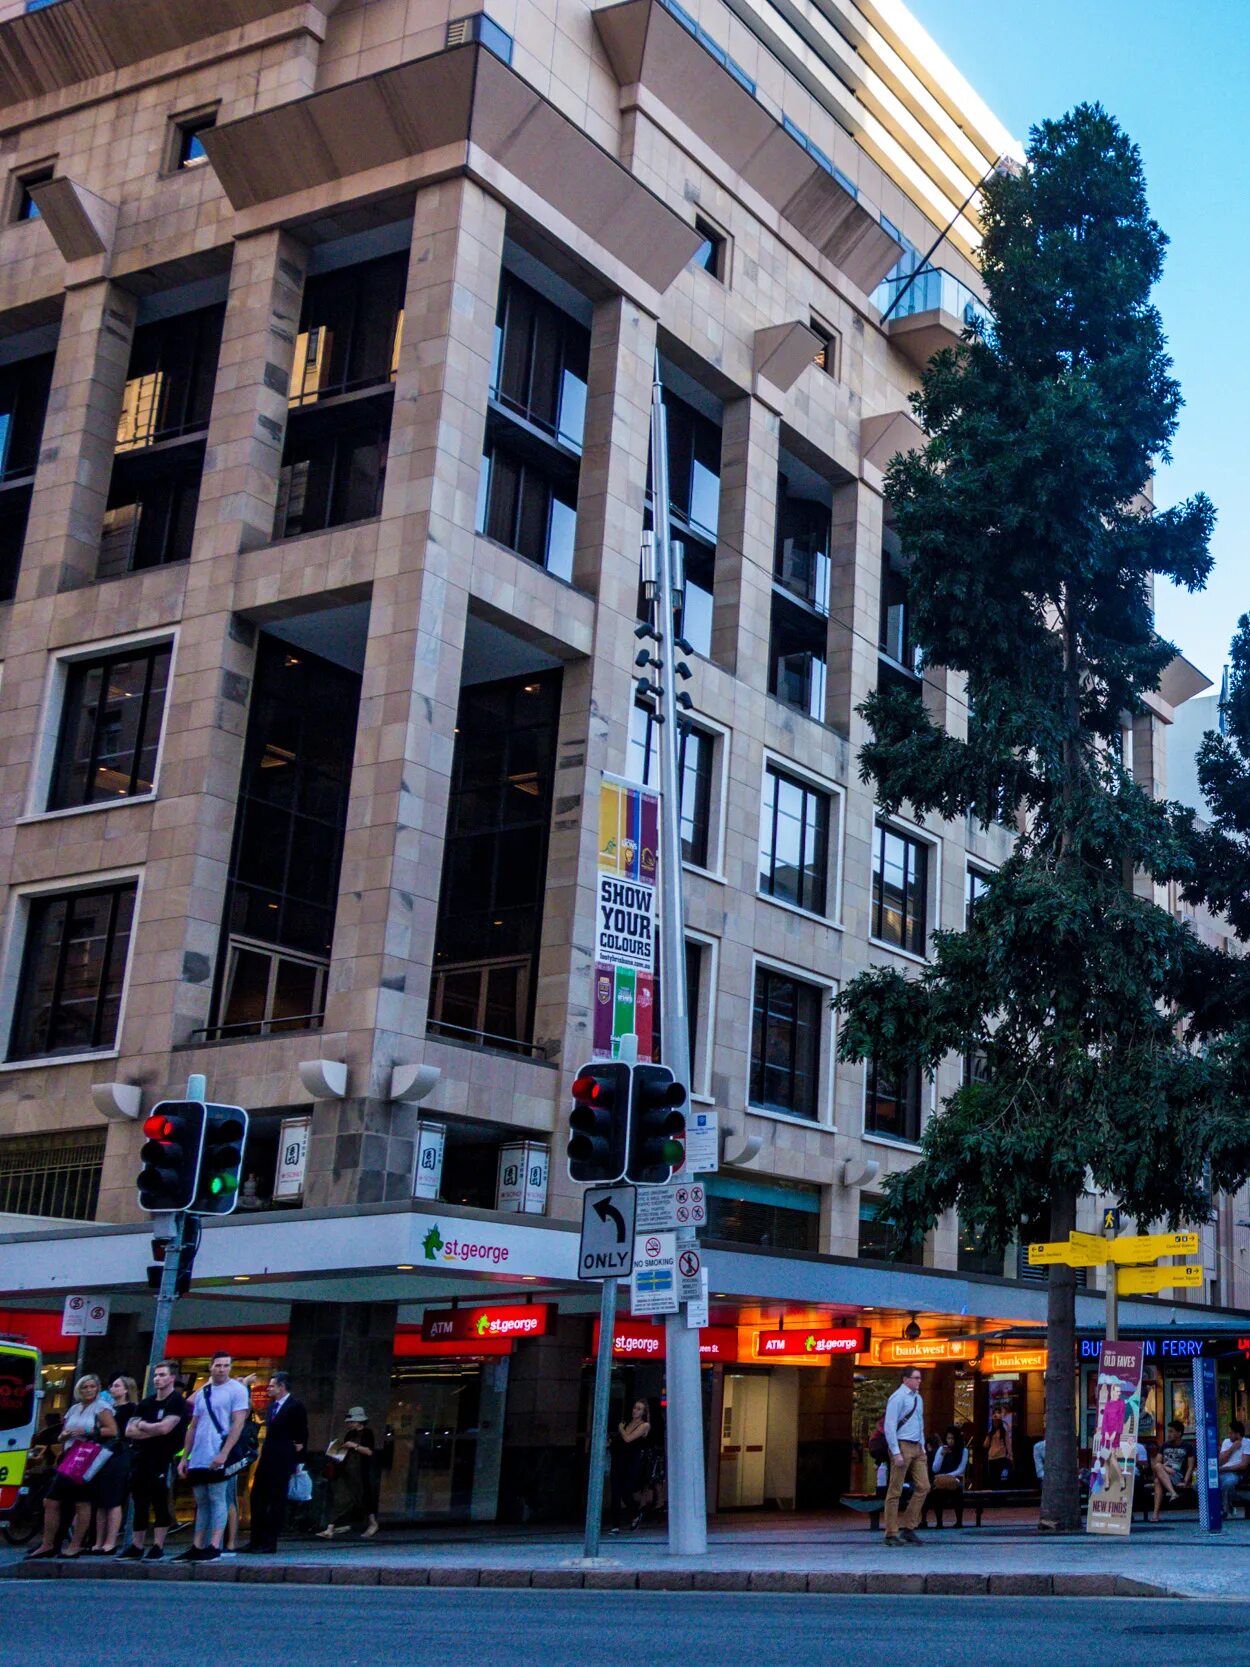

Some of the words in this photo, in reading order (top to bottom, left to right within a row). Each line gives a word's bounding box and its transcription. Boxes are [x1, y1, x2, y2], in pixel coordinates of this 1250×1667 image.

[601, 880, 652, 912] SHOW
[600, 905, 651, 940] YOUR
[600, 932, 651, 957] COLOURS
[445, 1240, 509, 1263] st.george
[584, 1251, 629, 1269] ONLY
[634, 1260, 643, 1268] NO
[644, 1258, 674, 1267] SMOKING
[431, 1321, 453, 1335] ATM
[490, 1318, 538, 1333] st.george
[615, 1335, 659, 1353] st.george
[765, 1339, 786, 1350] ATM
[815, 1338, 857, 1351] st.george
[895, 1343, 945, 1356] bankwest
[1081, 1340, 1102, 1356] BU
[1162, 1340, 1203, 1356] FERRY
[995, 1355, 1042, 1366] bankwest
[1104, 1355, 1116, 1367] OLD
[1116, 1355, 1136, 1368] FAVES
[1092, 1500, 1106, 1512] NEW
[1108, 1501, 1128, 1513] FINDS
